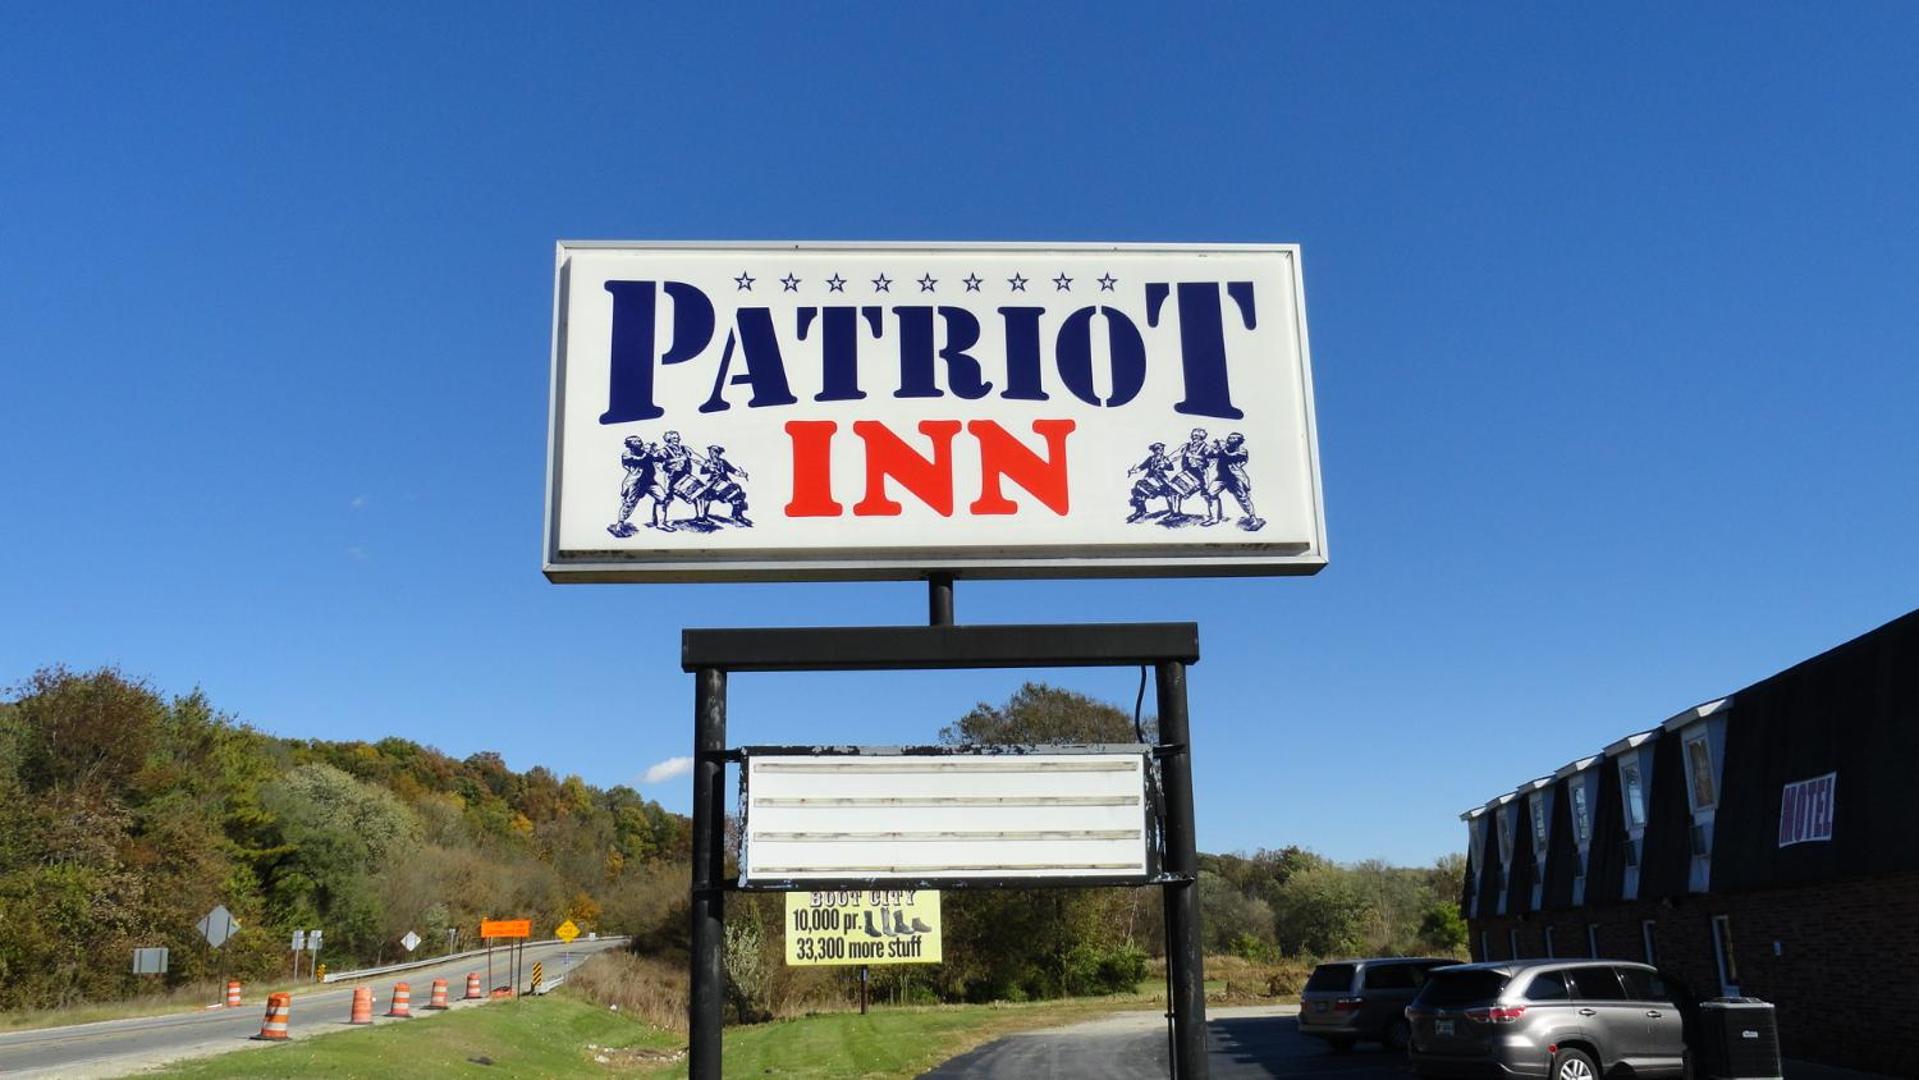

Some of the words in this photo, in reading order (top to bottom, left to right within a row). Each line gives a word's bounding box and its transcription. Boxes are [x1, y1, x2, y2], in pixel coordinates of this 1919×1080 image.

[599, 279, 1256, 425] PATRIOT
[784, 419, 1076, 518] INN
[1780, 778, 1833, 844] MOTEL
[793, 908, 839, 935] 10,000
[843, 913, 862, 935] pr.
[810, 890, 862, 908] BOOT
[869, 890, 916, 907] CITY
[796, 937, 844, 963] 33,300
[849, 941, 885, 959] more
[888, 935, 922, 958] stuff
